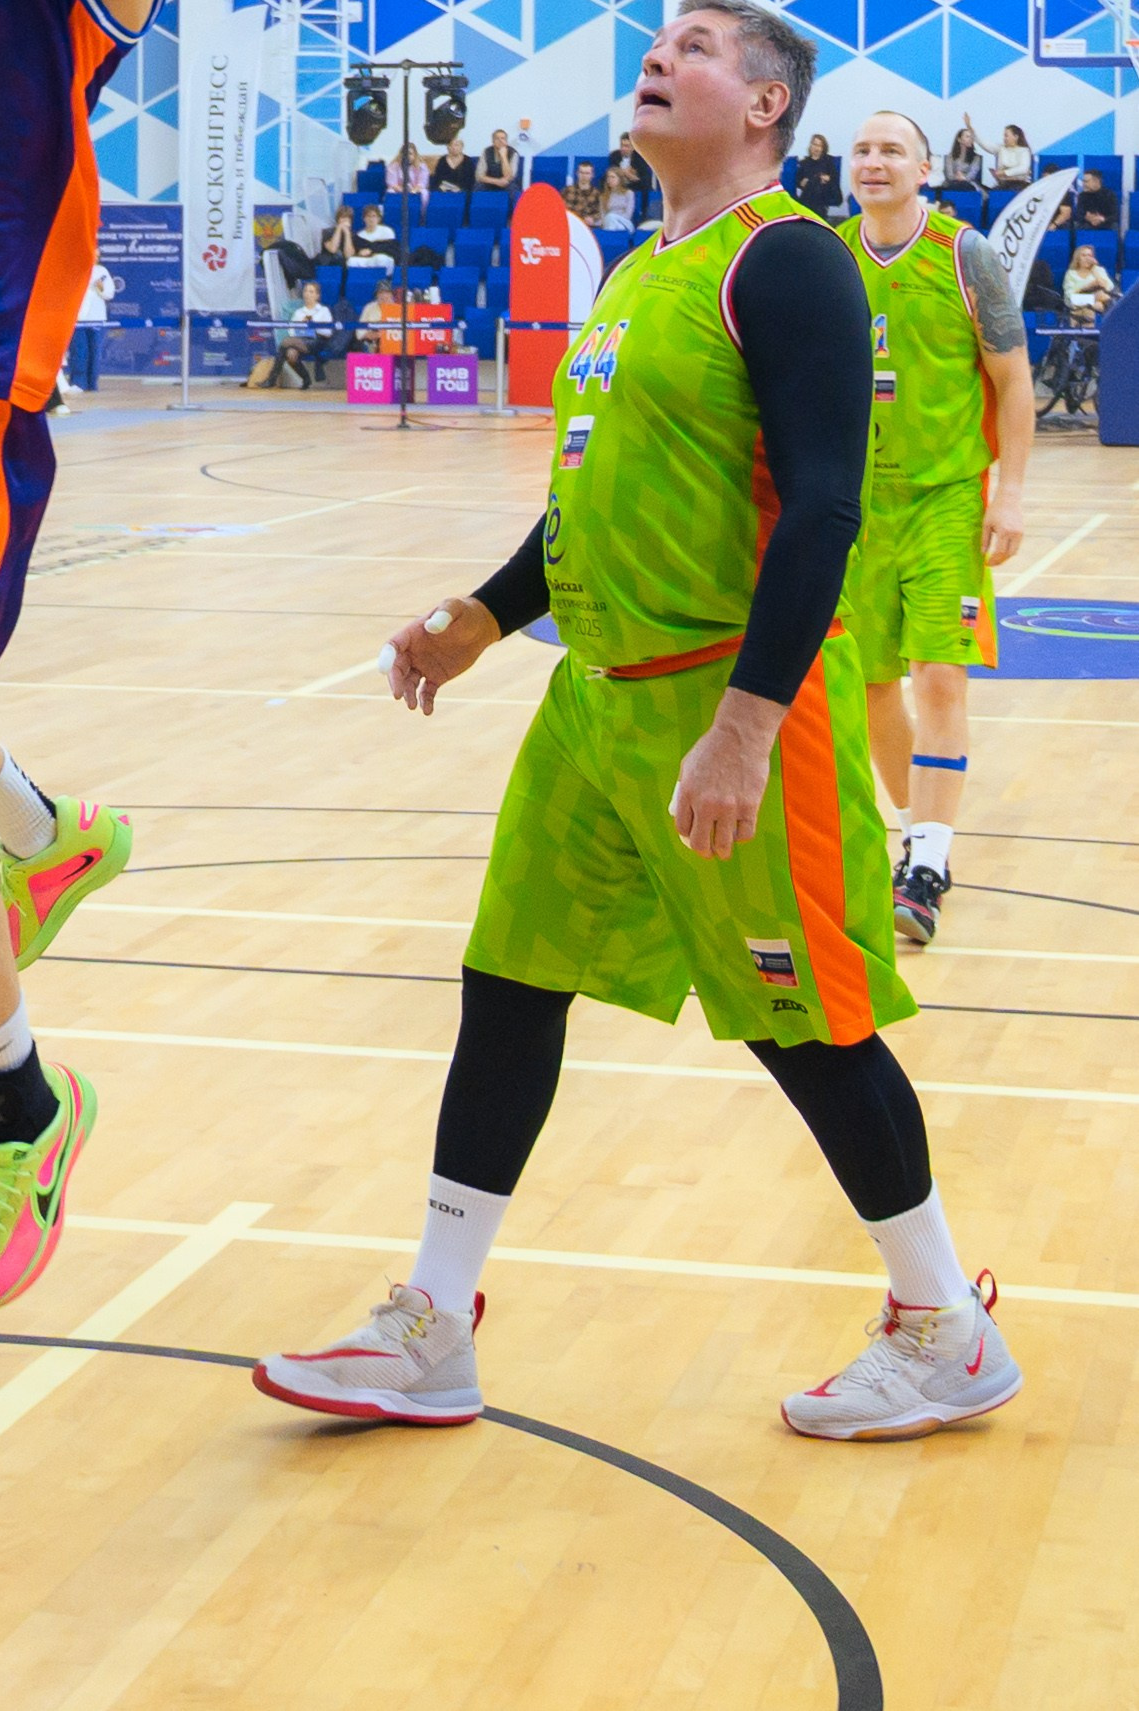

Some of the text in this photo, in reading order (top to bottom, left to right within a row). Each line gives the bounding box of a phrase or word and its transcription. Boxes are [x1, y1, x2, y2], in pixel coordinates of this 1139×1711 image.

[234, 81, 249, 165] побеждай
[207, 54, 229, 239] РОСКОНГРЕСС
[567, 319, 630, 394] 44
[354, 366, 384, 379] РИВ
[436, 367, 469, 380] РИВ
[354, 378, 384, 392] ГОШ
[436, 379, 469, 393] ГОШ
[770, 998, 809, 1015] ZEDO
